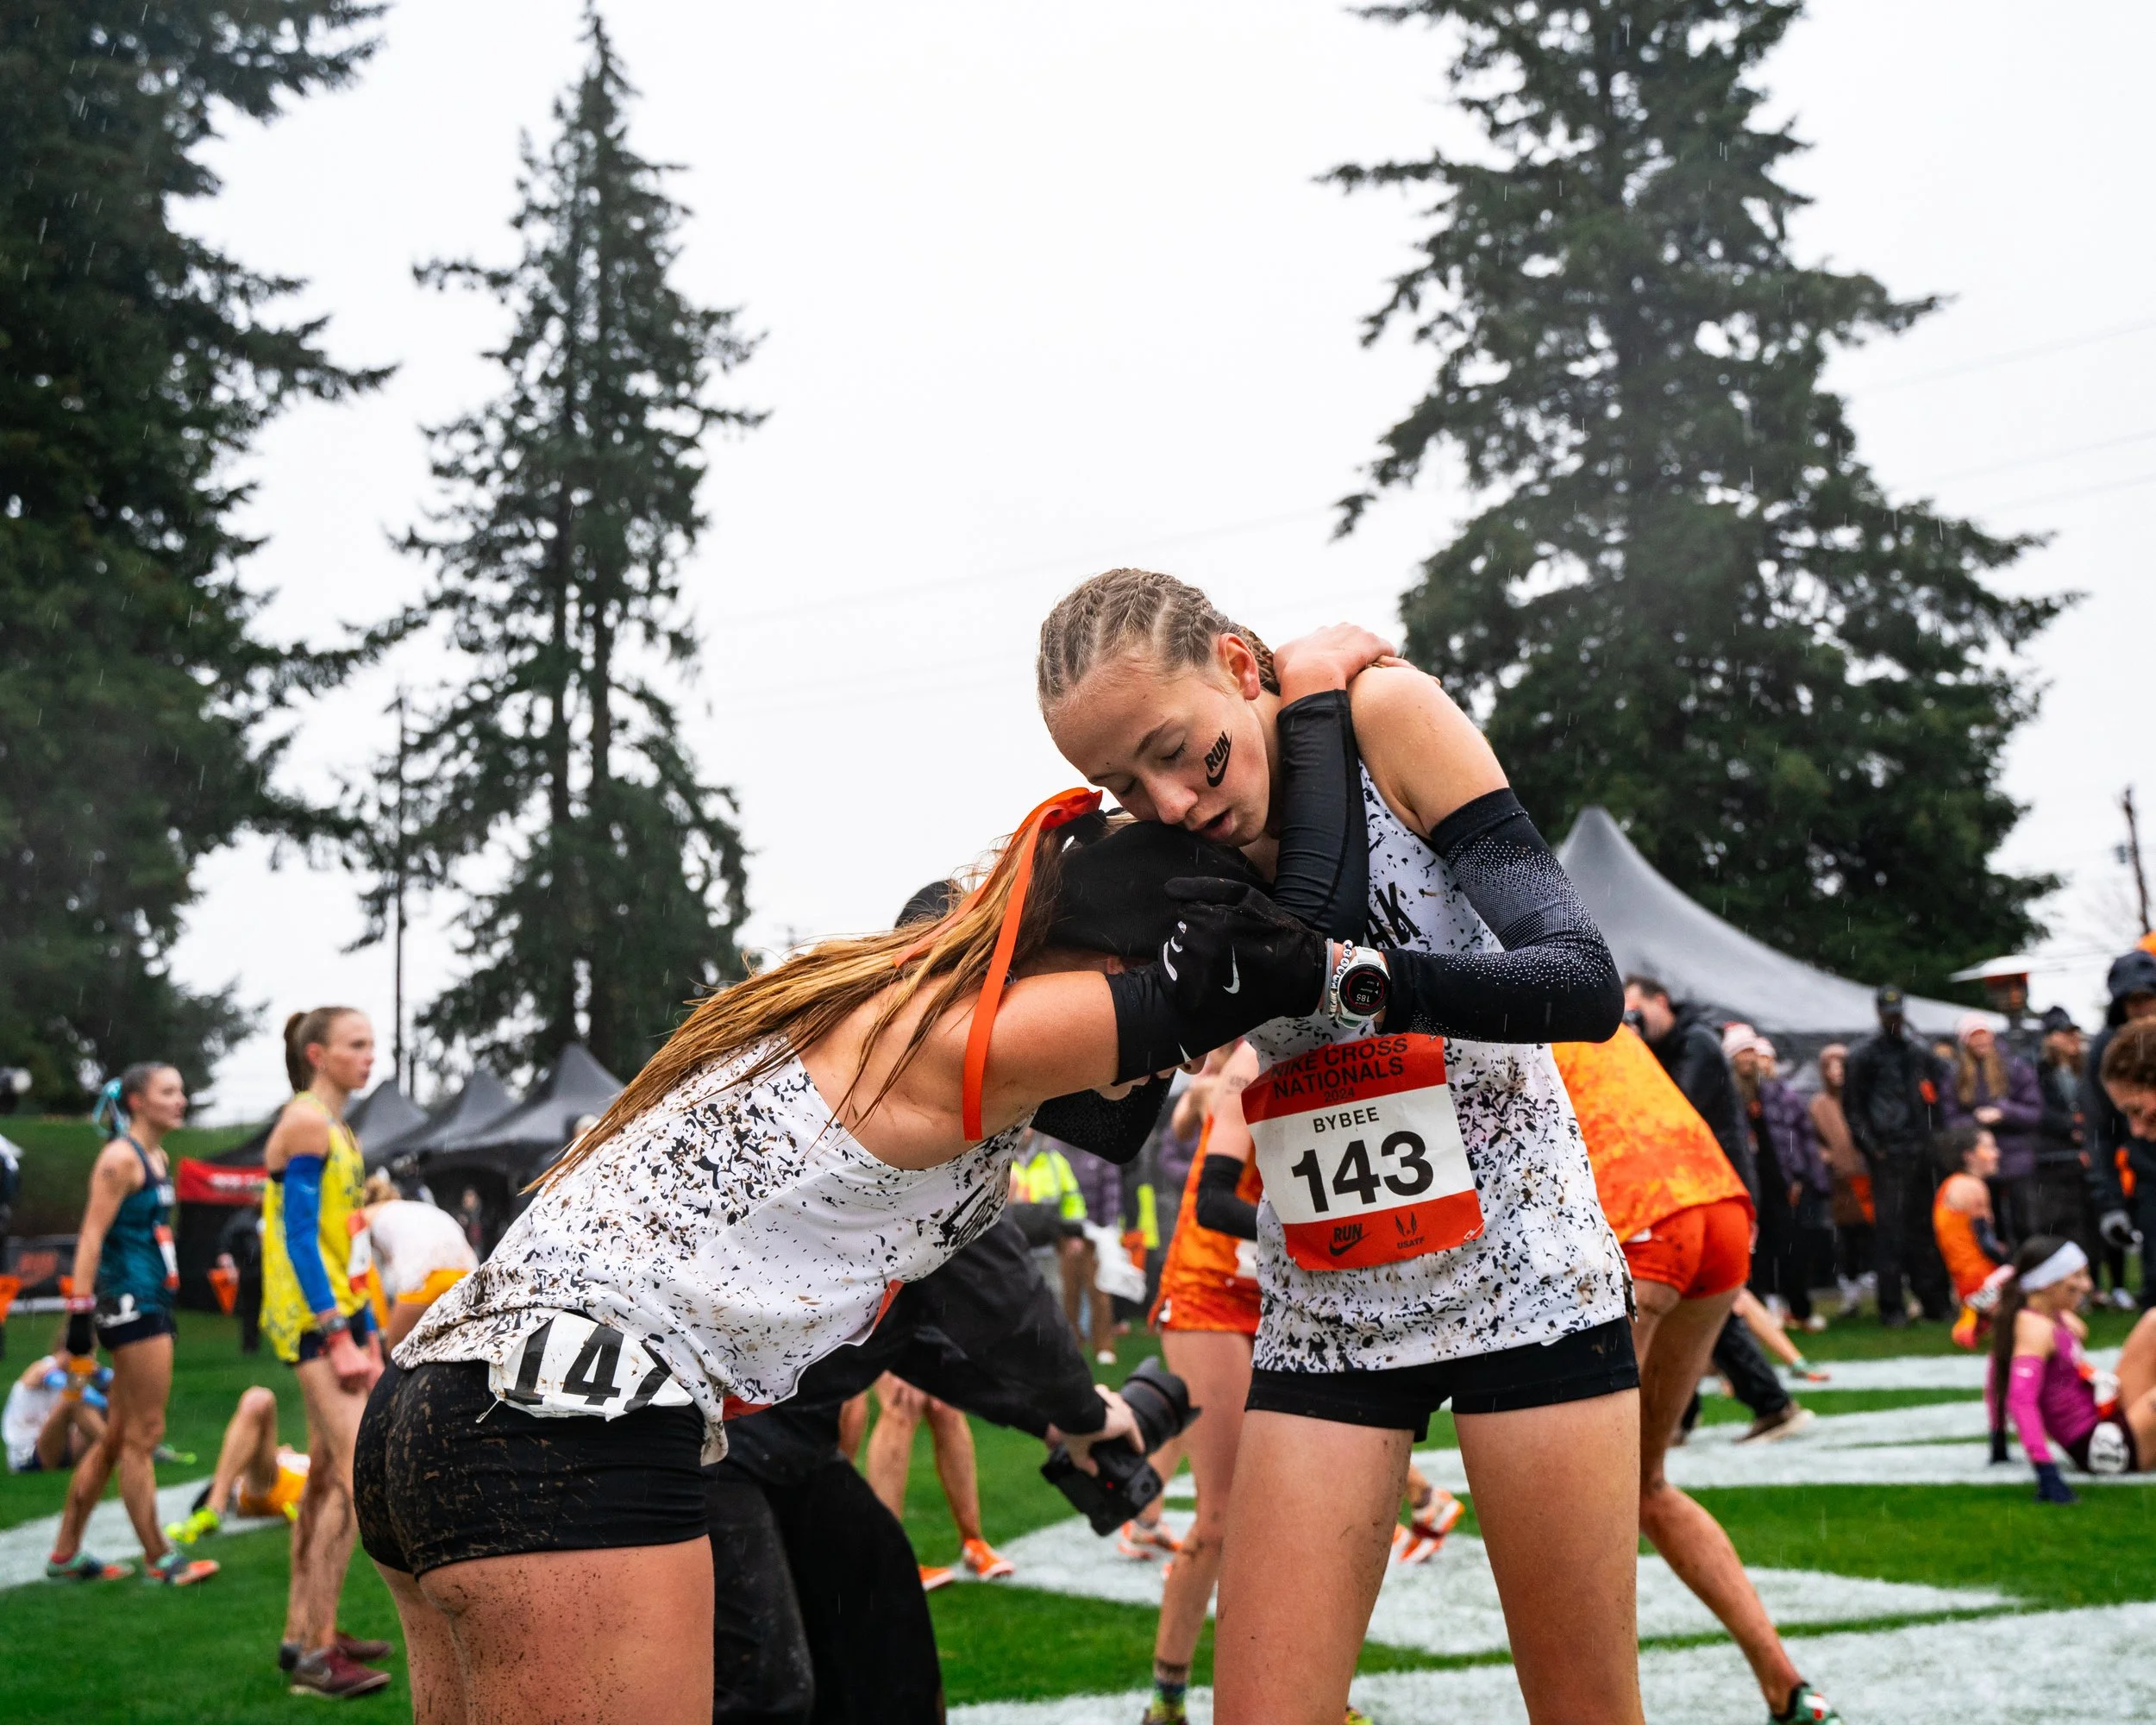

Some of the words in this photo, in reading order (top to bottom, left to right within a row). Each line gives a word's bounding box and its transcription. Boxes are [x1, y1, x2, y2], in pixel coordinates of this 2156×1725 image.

[1204, 731, 1230, 773] RUN
[1363, 881, 1422, 950] AK
[1270, 1049, 1318, 1077] NIKE
[1324, 1038, 1407, 1066] CROSS
[1273, 1057, 1404, 1100] NATIONALS
[1324, 1088, 1355, 1103] 2024
[1313, 1107, 1380, 1133] BYBEE
[1291, 1131, 1434, 1213] 143
[1333, 1223, 1362, 1242] RUN
[1397, 1236, 1425, 1249] USATF
